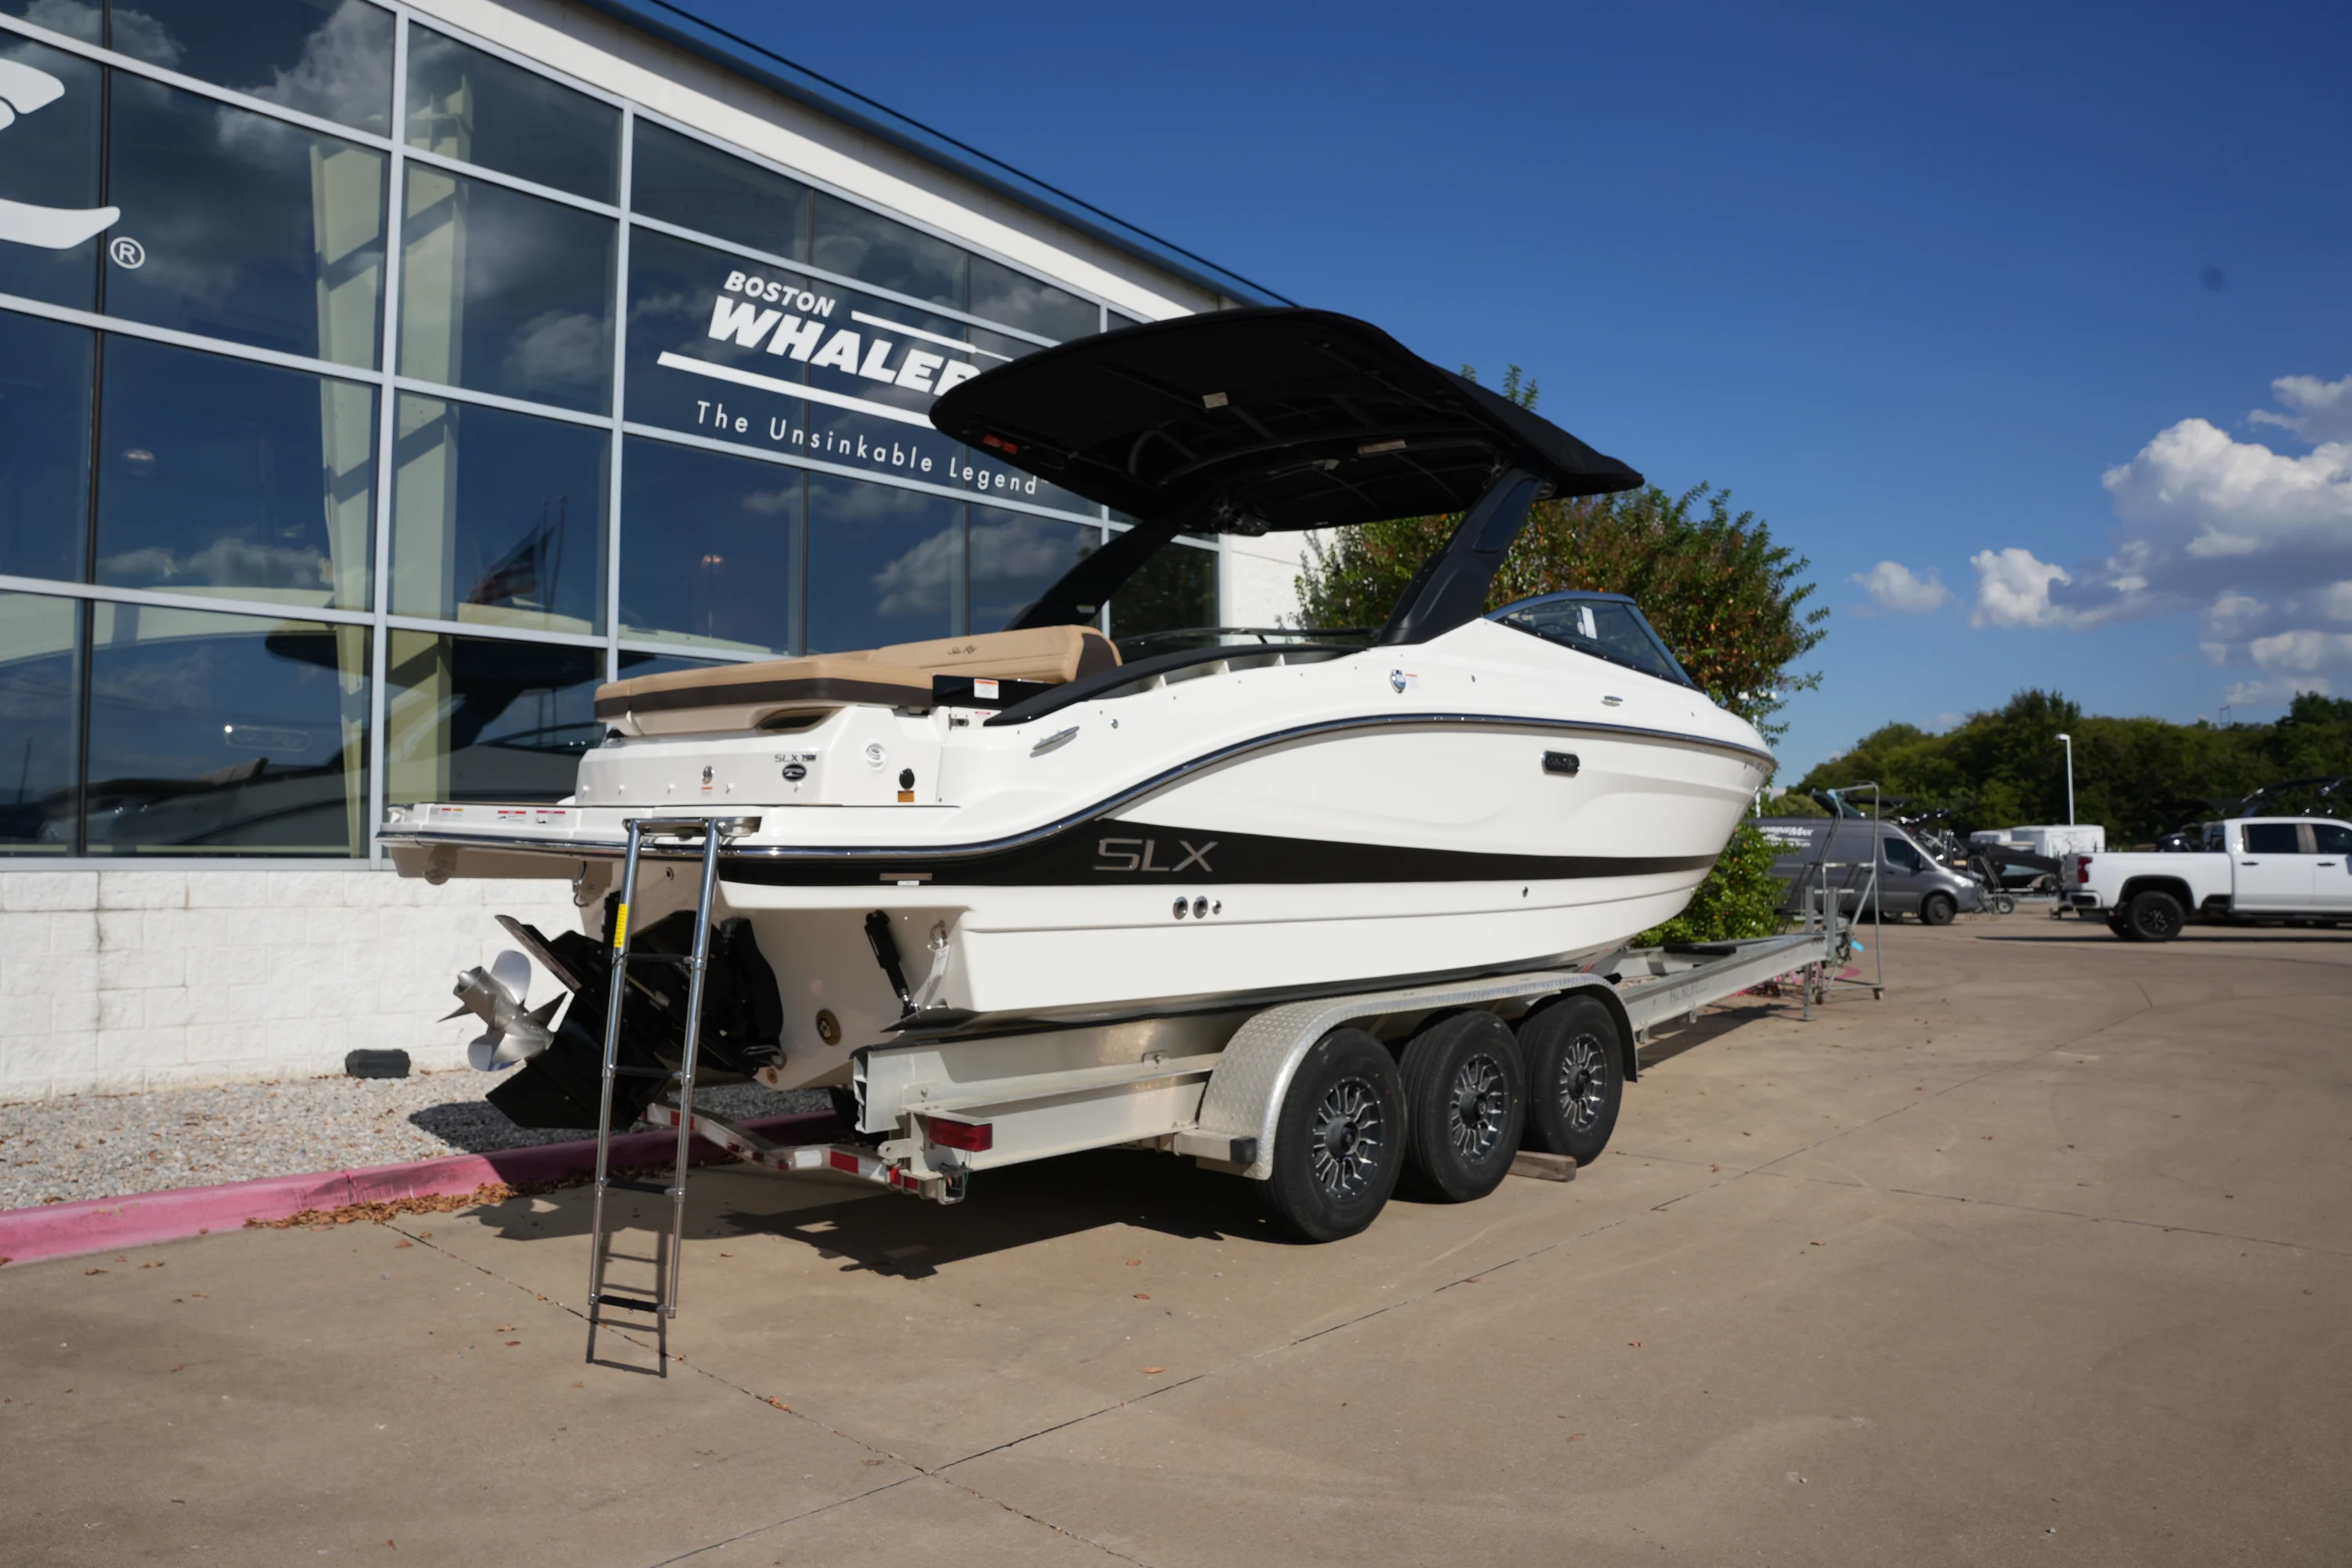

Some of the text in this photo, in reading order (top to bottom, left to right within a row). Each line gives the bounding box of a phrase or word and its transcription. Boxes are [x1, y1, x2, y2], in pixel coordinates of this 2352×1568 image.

[724, 270, 836, 318] BOSTON
[697, 400, 1037, 495] The Unsinkable Legend
[1092, 837, 1218, 873] SLX
